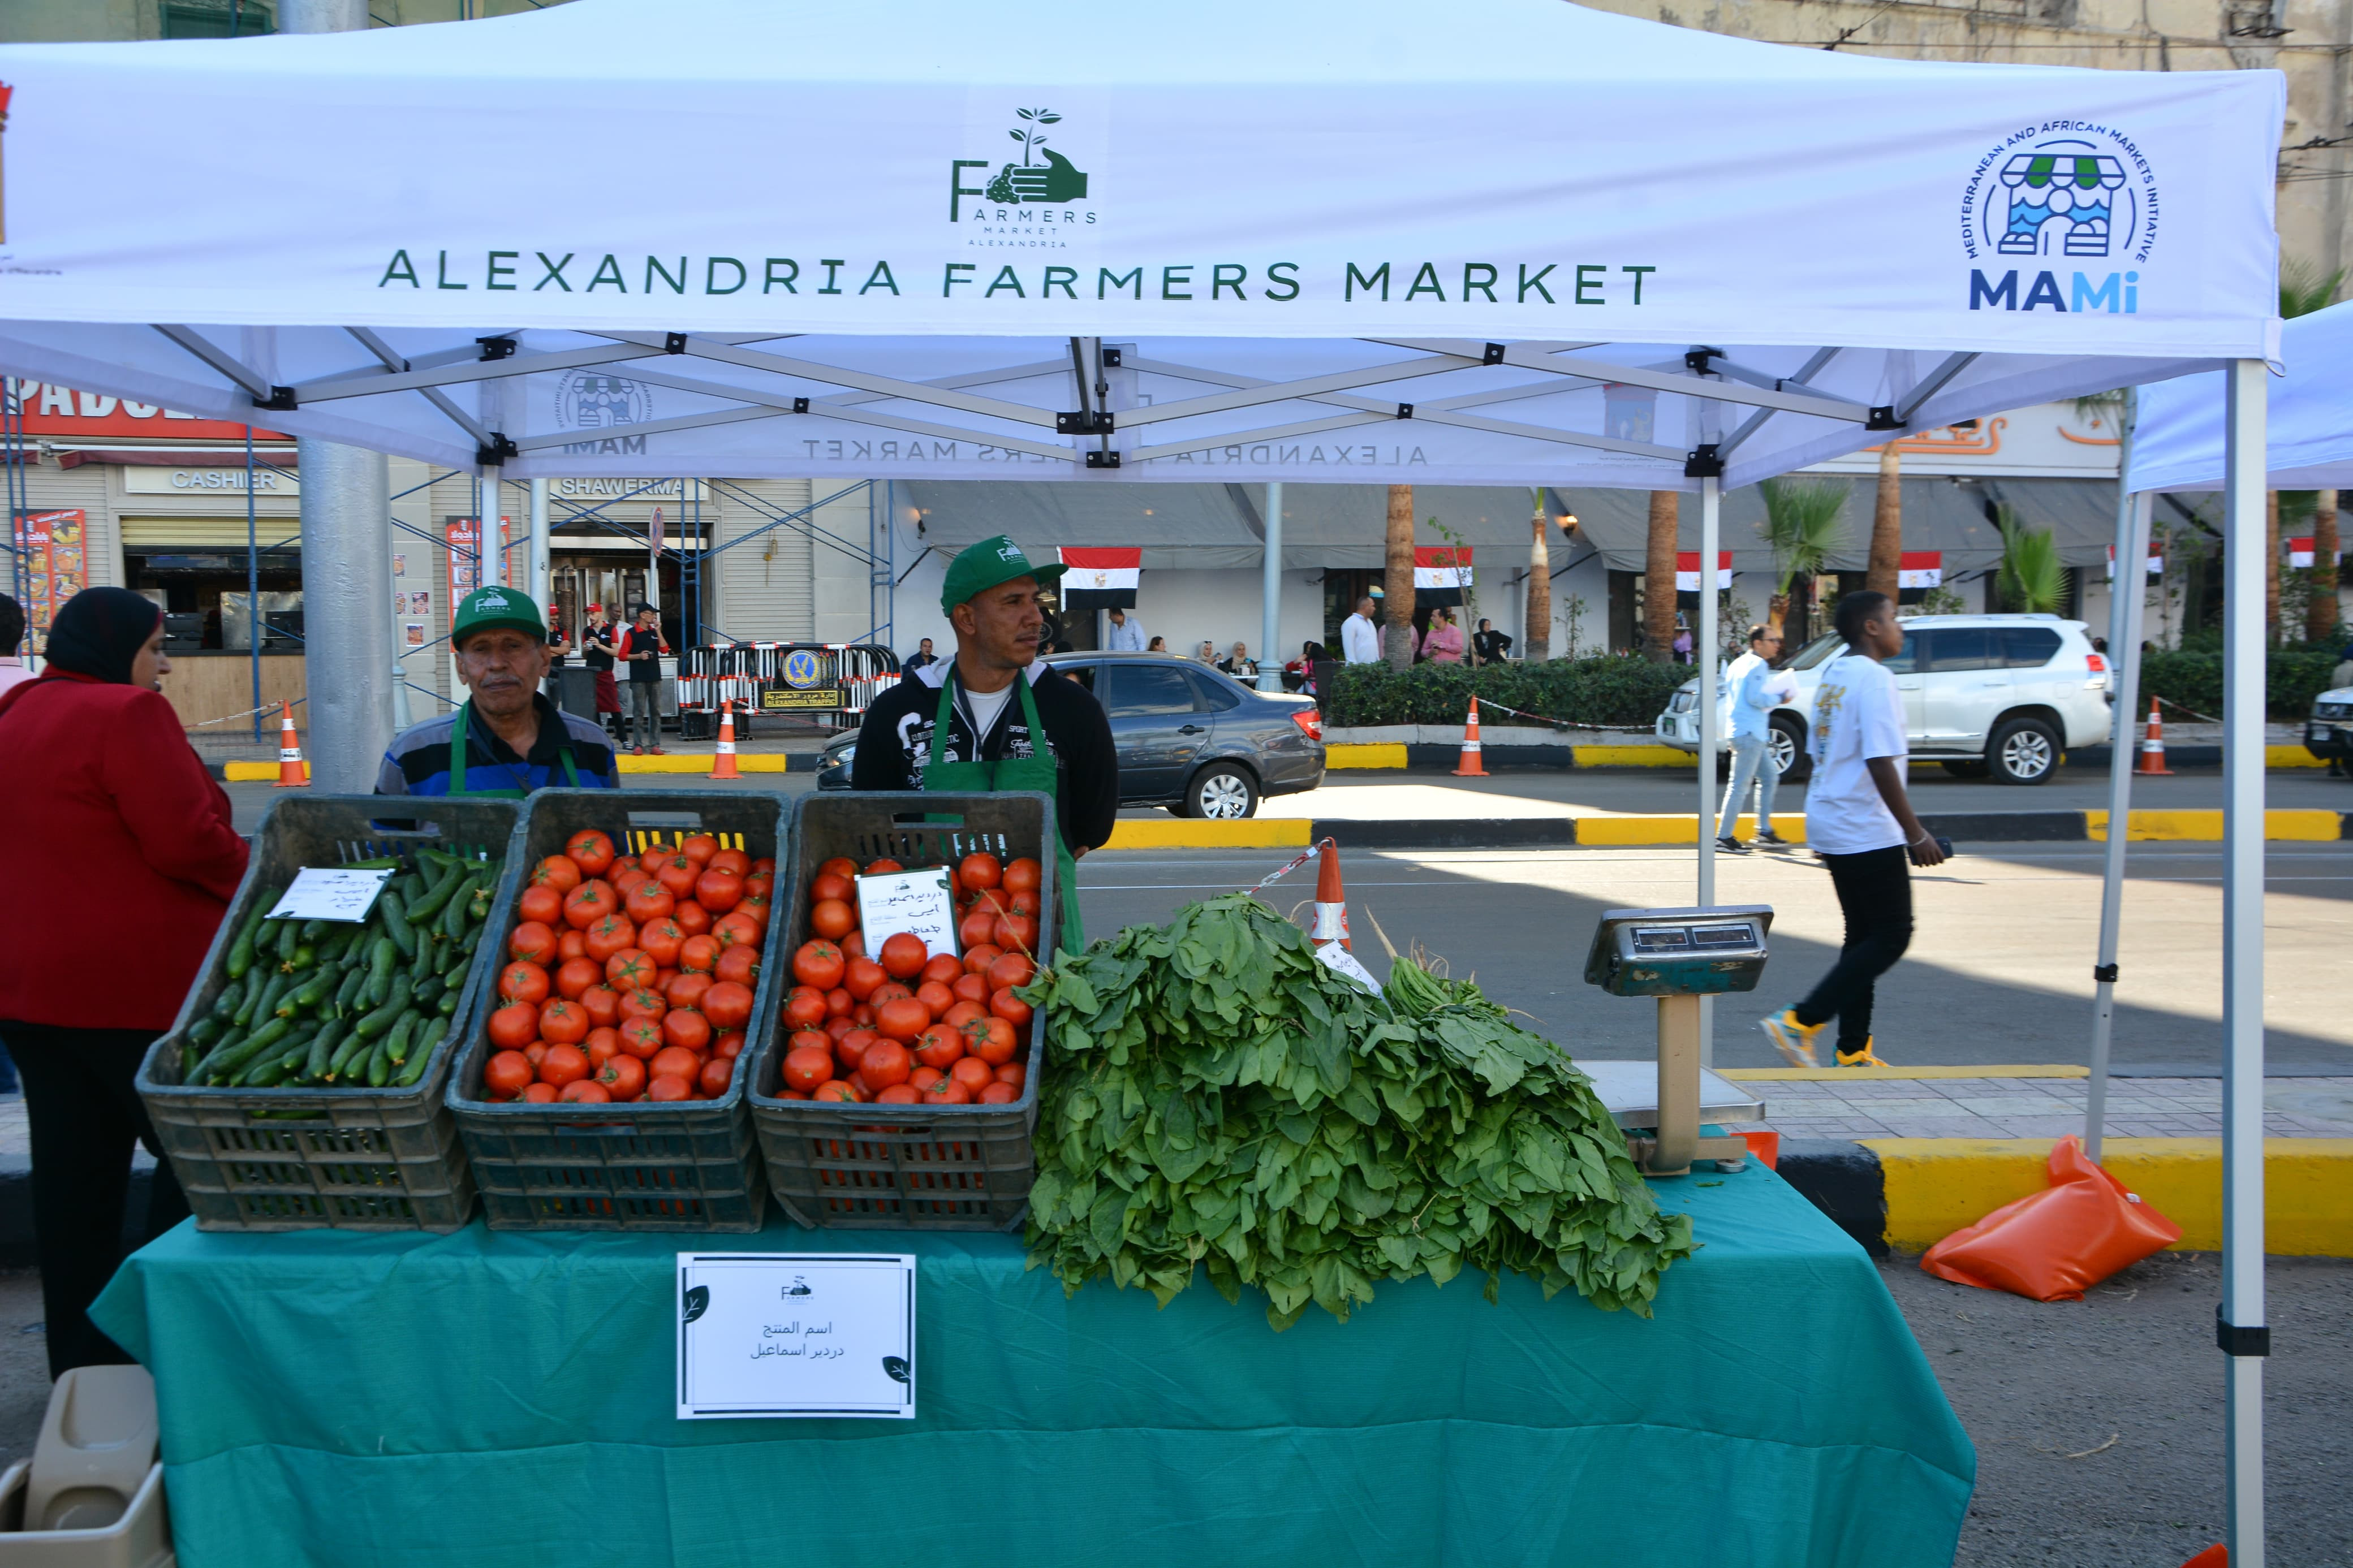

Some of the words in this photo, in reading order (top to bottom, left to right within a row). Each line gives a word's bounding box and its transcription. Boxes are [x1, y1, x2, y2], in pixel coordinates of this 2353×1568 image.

[950, 160, 1096, 224] FARMERS
[1961, 145, 2005, 260] MEDITERRANEAN
[2007, 127, 2036, 147] AND
[2041, 120, 2106, 135] AFRICAN
[2109, 129, 2154, 184] MARKETS
[2135, 187, 2159, 264] INITIATIVE
[378, 249, 900, 296] ALEXANDRIA
[943, 262, 1300, 302] FARMERS
[1345, 262, 1656, 305] MARKET
[1969, 269, 2139, 314] MAMi
[171, 471, 277, 489] CASHIER
[561, 478, 682, 495] SHAWERMA
[763, 1320, 799, 1338] المنتج
[805, 1321, 831, 1338] اسم
[810, 1347, 844, 1359] دردير
